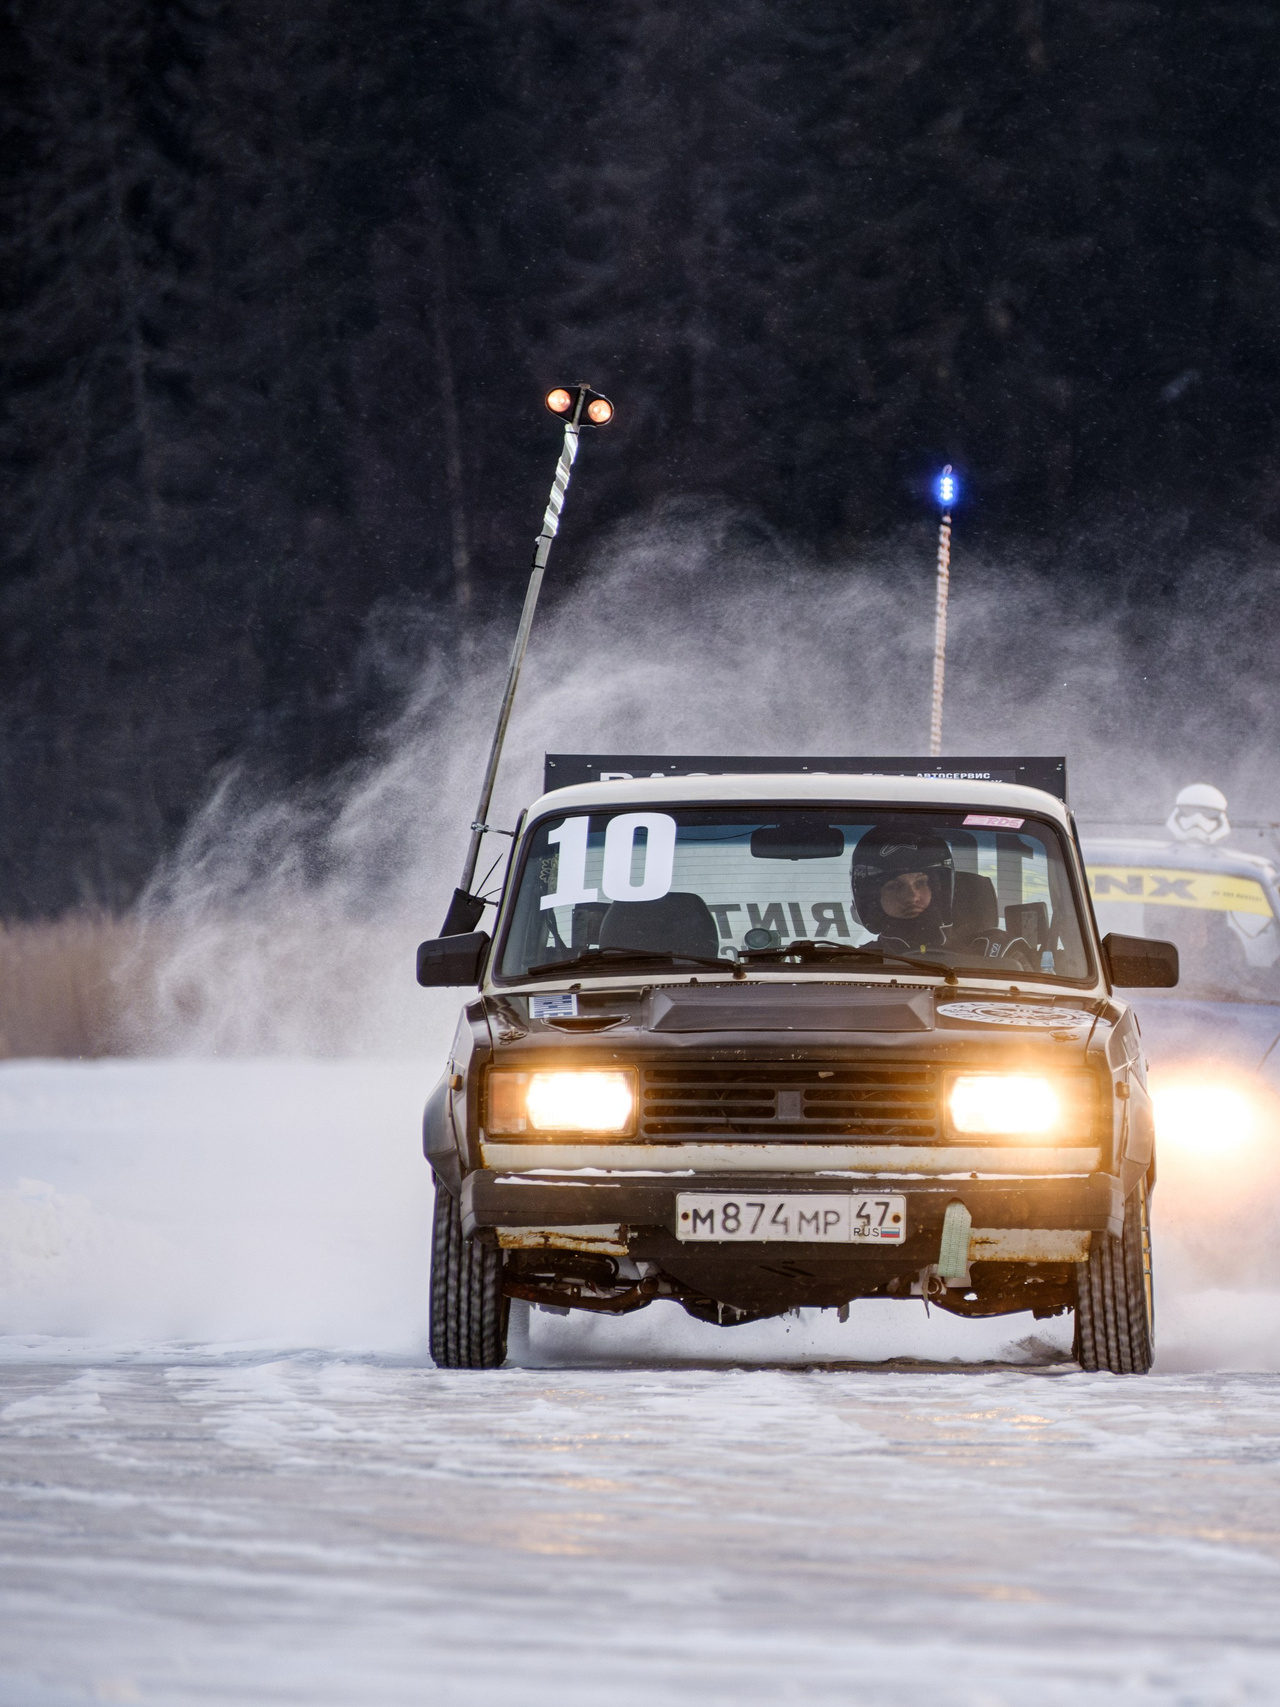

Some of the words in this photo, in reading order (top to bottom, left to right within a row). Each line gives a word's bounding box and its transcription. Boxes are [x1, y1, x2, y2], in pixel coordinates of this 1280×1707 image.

[540, 812, 677, 911] 10
[1089, 873, 1198, 901] NX
[856, 1201, 890, 1226] 47
[853, 1227, 880, 1237] RUS
